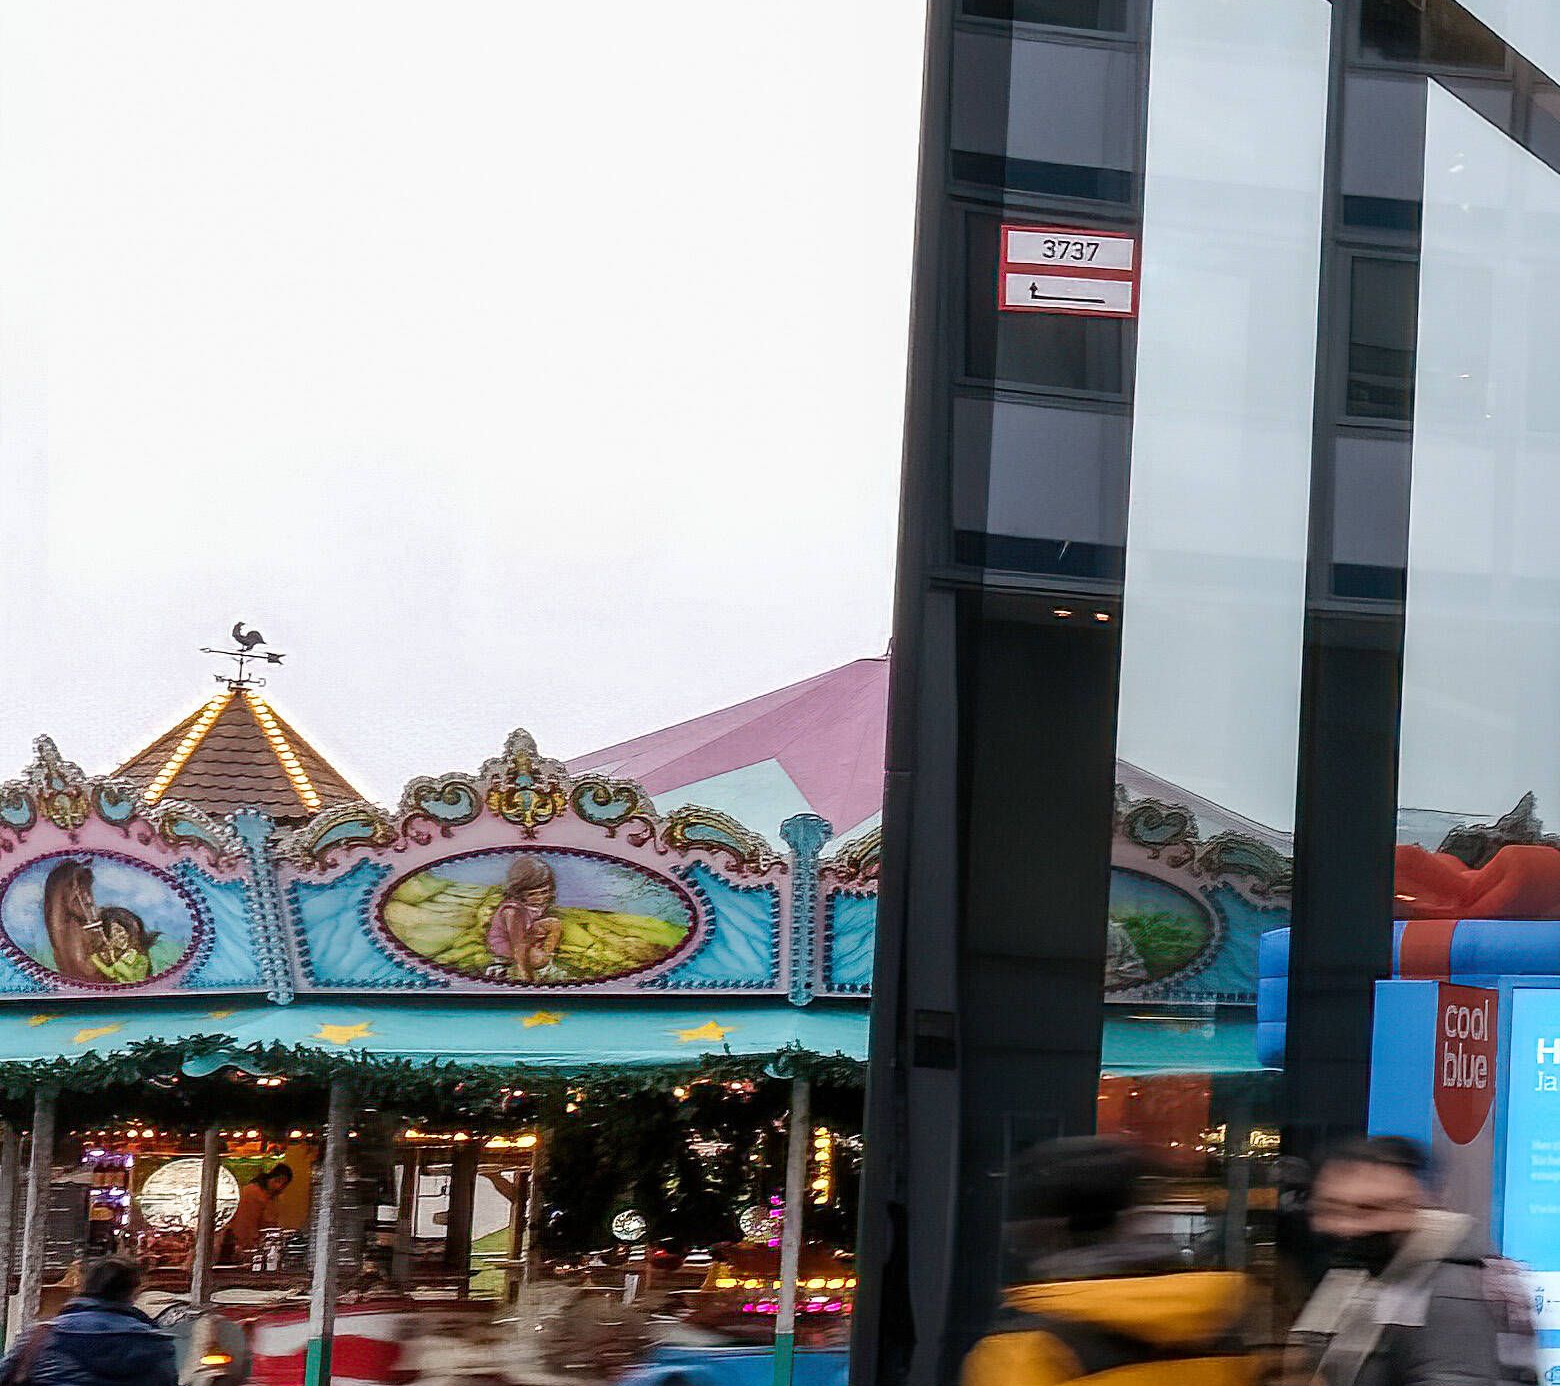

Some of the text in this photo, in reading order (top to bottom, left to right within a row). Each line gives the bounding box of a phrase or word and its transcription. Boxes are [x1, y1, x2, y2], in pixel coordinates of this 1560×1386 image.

[1041, 239, 1100, 262] 3737
[1443, 997, 1490, 1043] cool
[1443, 1046, 1489, 1091] blue
[1535, 1071, 1557, 1093] Ja
